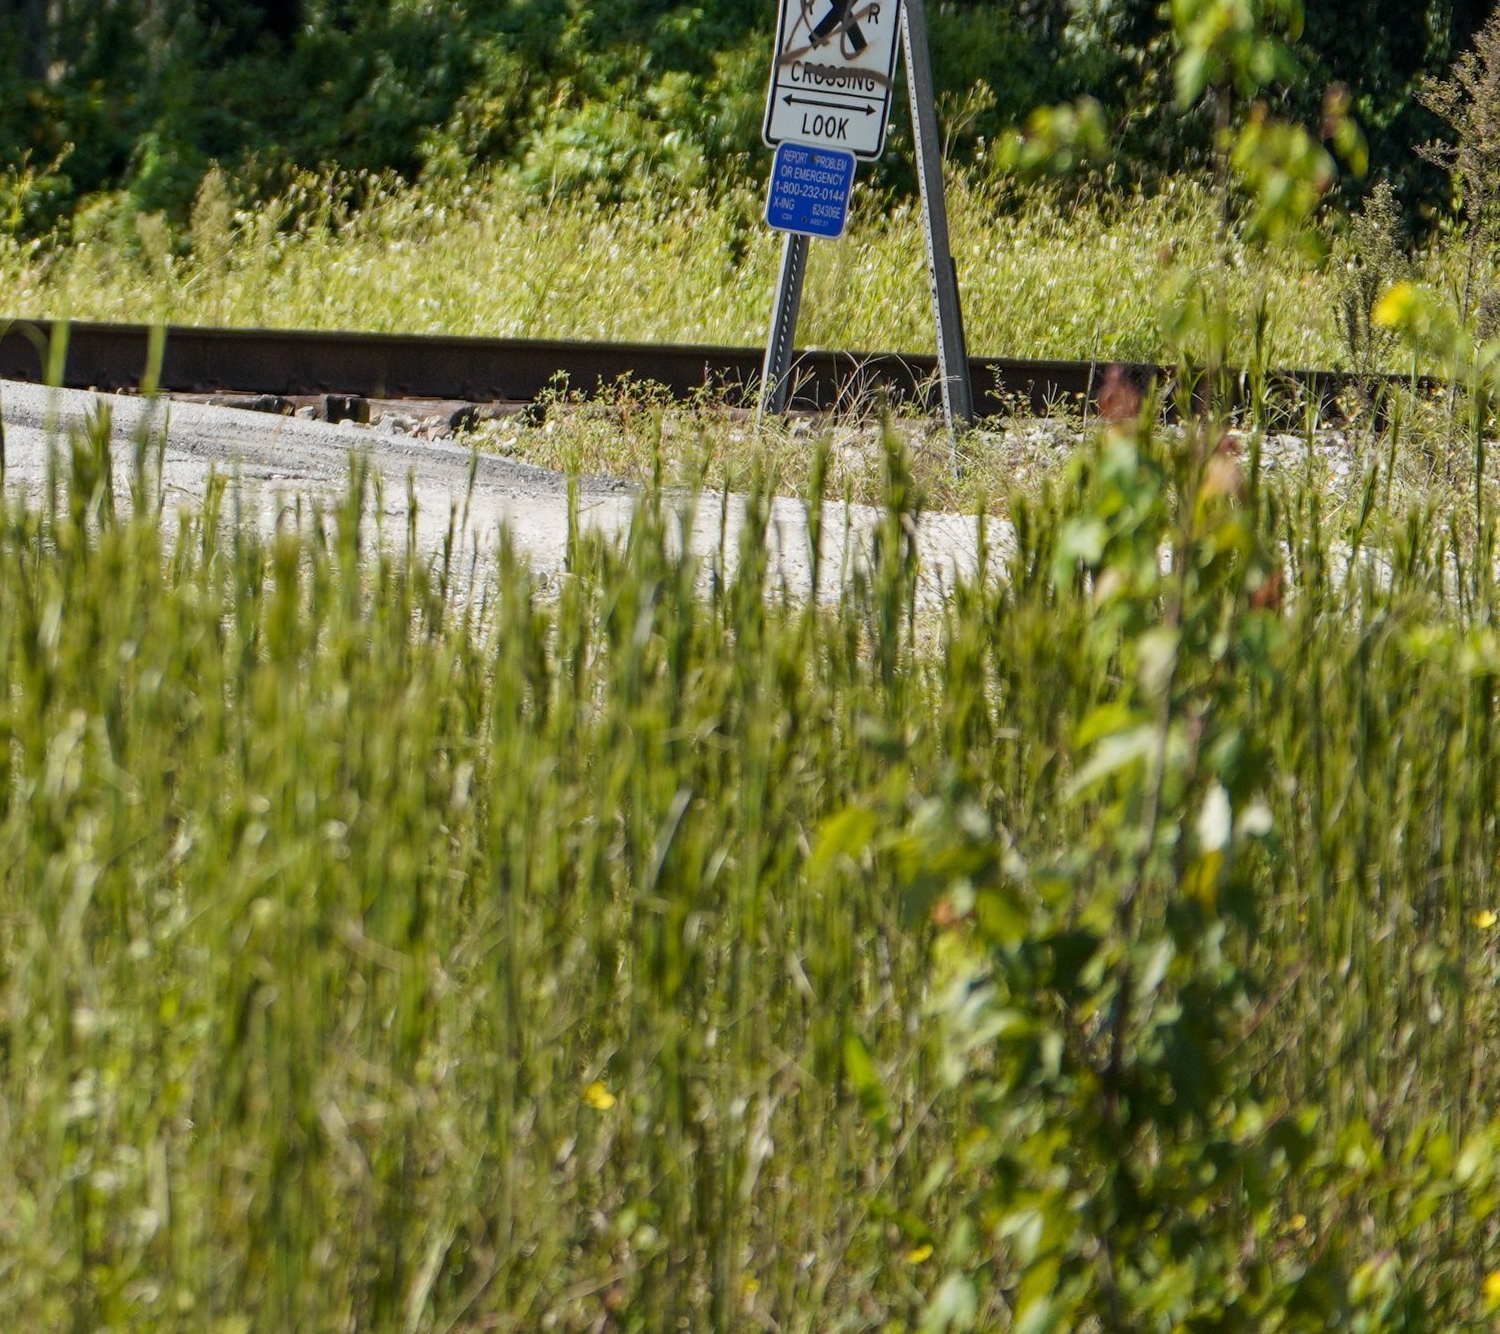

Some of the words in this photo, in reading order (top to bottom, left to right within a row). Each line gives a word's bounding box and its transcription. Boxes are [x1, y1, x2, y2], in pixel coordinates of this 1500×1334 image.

[867, 2, 881, 25] R
[801, 113, 849, 140] LOOK
[783, 150, 808, 164] REPORT
[816, 156, 847, 171] PROBLEM
[781, 165, 793, 178] OR
[794, 168, 844, 186] EMERGENCY
[775, 181, 844, 202] 1-800-232-0144
